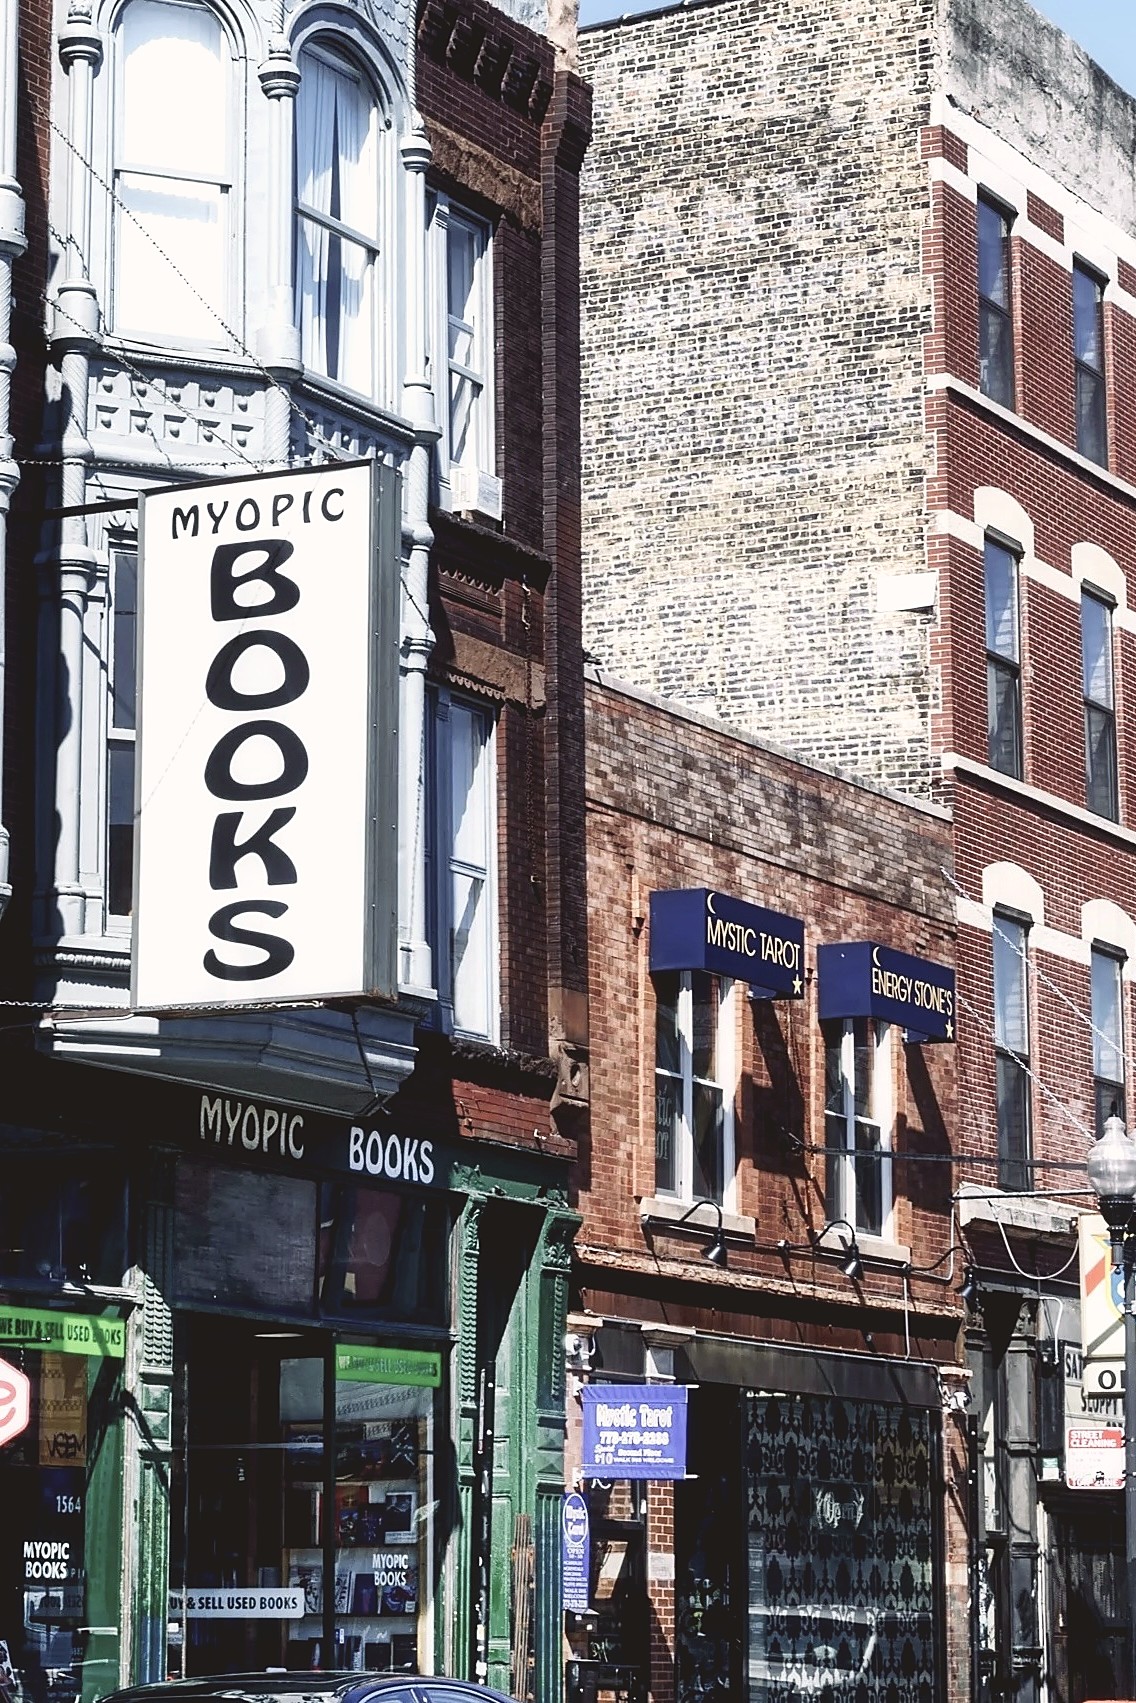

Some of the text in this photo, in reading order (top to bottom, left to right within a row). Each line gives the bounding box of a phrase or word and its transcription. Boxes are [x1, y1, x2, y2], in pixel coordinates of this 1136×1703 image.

[172, 488, 345, 539] MYOPIC
[203, 539, 310, 982] BOOKS
[707, 916, 800, 971] MYSTIC TAROT
[872, 967, 953, 1017] ENERGY STONE'S
[200, 1094, 434, 1184] MYOPIC BOOKS
[15, 1318, 33, 1336] BUY
[67, 1324, 90, 1342] USED
[1098, 1370, 1127, 1389] O
[595, 1404, 674, 1428] Mystic Tarot
[1070, 1430, 1104, 1439] STREET
[1070, 1439, 1117, 1448] CLEANING
[56, 1495, 82, 1514] 1564
[23, 1541, 70, 1560] MYOPIC
[25, 1561, 67, 1579] BOOKS
[372, 1553, 409, 1570] MYOPIC
[374, 1571, 407, 1587] BOOKS
[186, 1597, 196, 1610] &
[198, 1596, 225, 1610] SELL
[227, 1596, 257, 1610] USED
[259, 1597, 298, 1610] BOOKS
